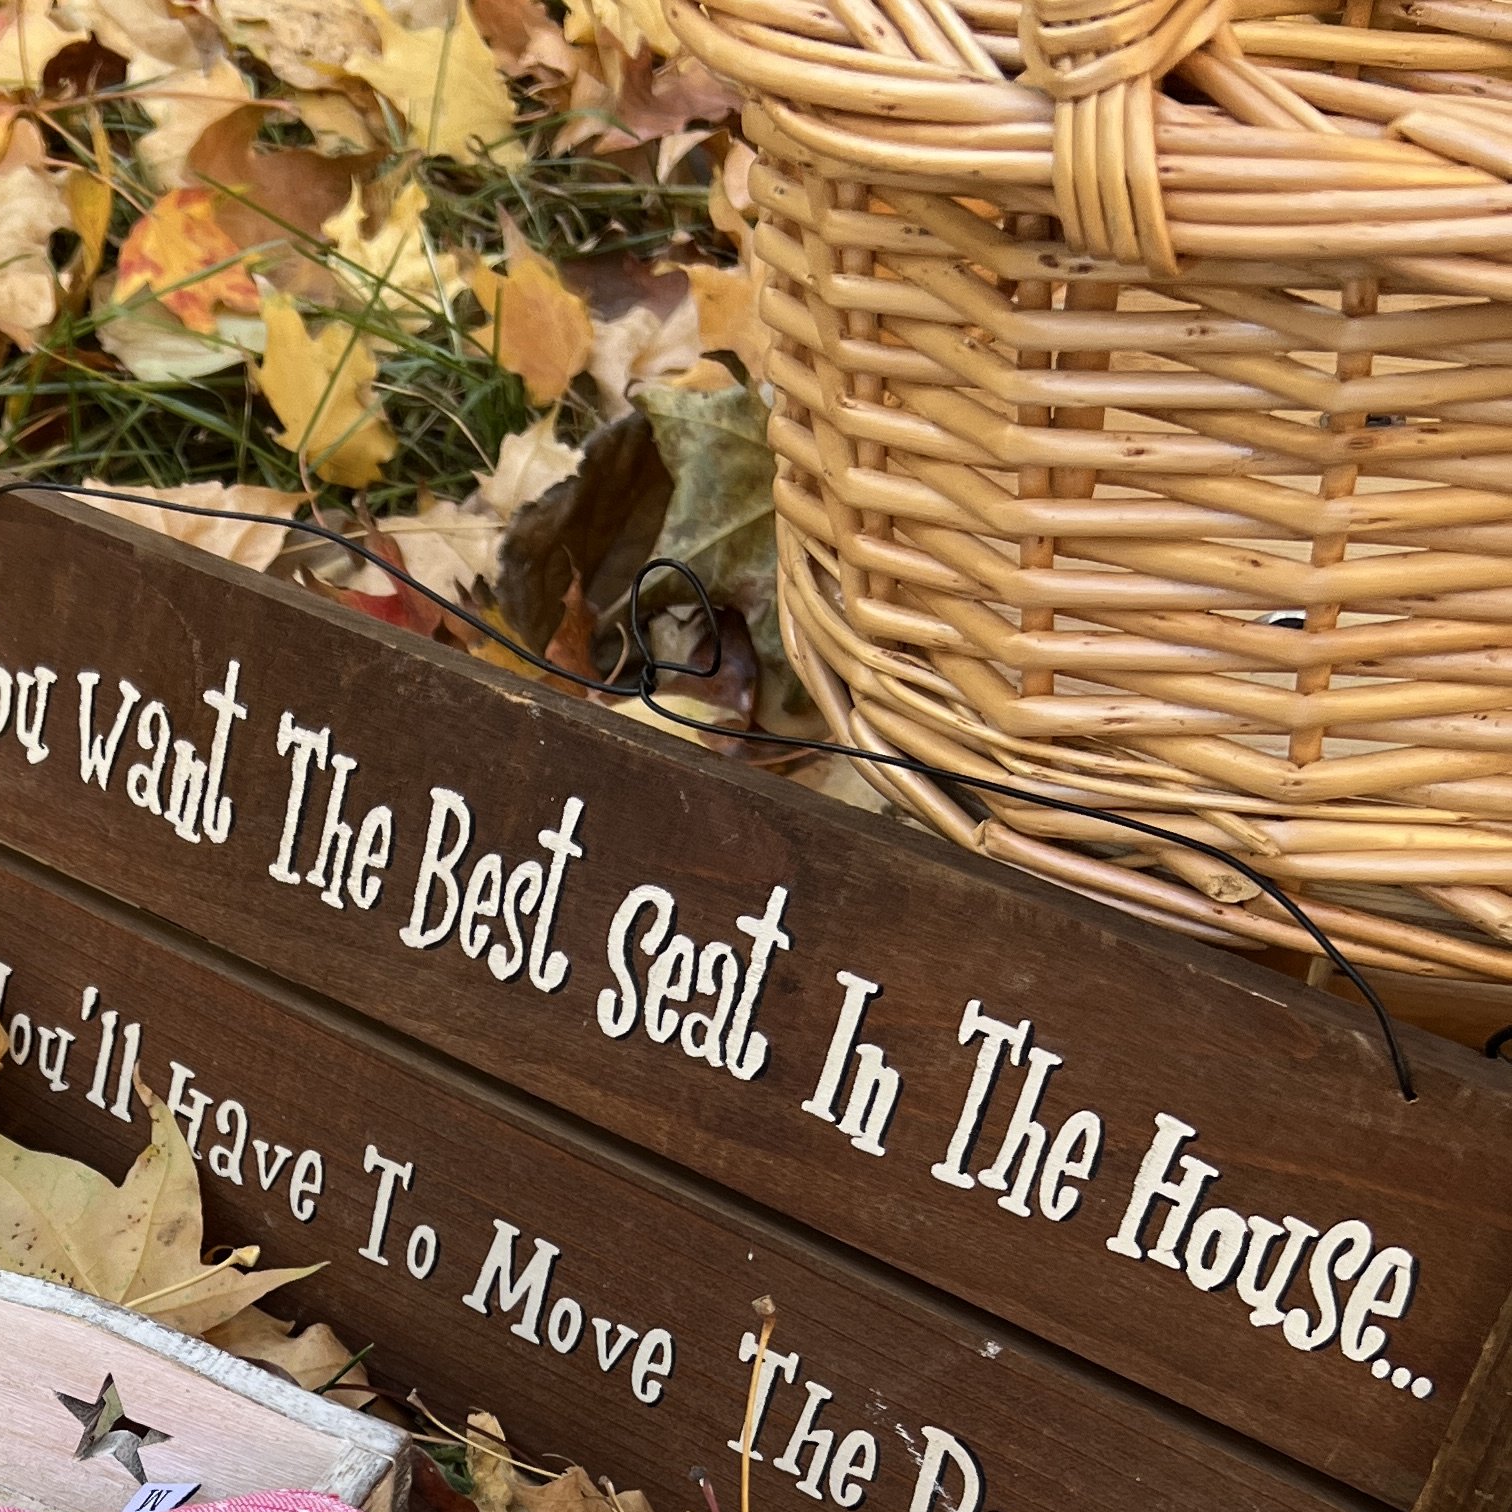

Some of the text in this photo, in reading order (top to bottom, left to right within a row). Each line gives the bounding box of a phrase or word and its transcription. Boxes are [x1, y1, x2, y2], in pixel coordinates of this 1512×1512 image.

[168, 1060, 324, 1222] Have
[358, 1144, 438, 1280] To
[461, 1218, 674, 1405] Move
[726, 1331, 880, 1509] The
[268, 711, 393, 910] The
[399, 787, 585, 993] Best
[596, 884, 790, 1081] Seat
[801, 970, 900, 1157] In
[930, 999, 1101, 1223] The
[1105, 1112, 1435, 1400] House...
